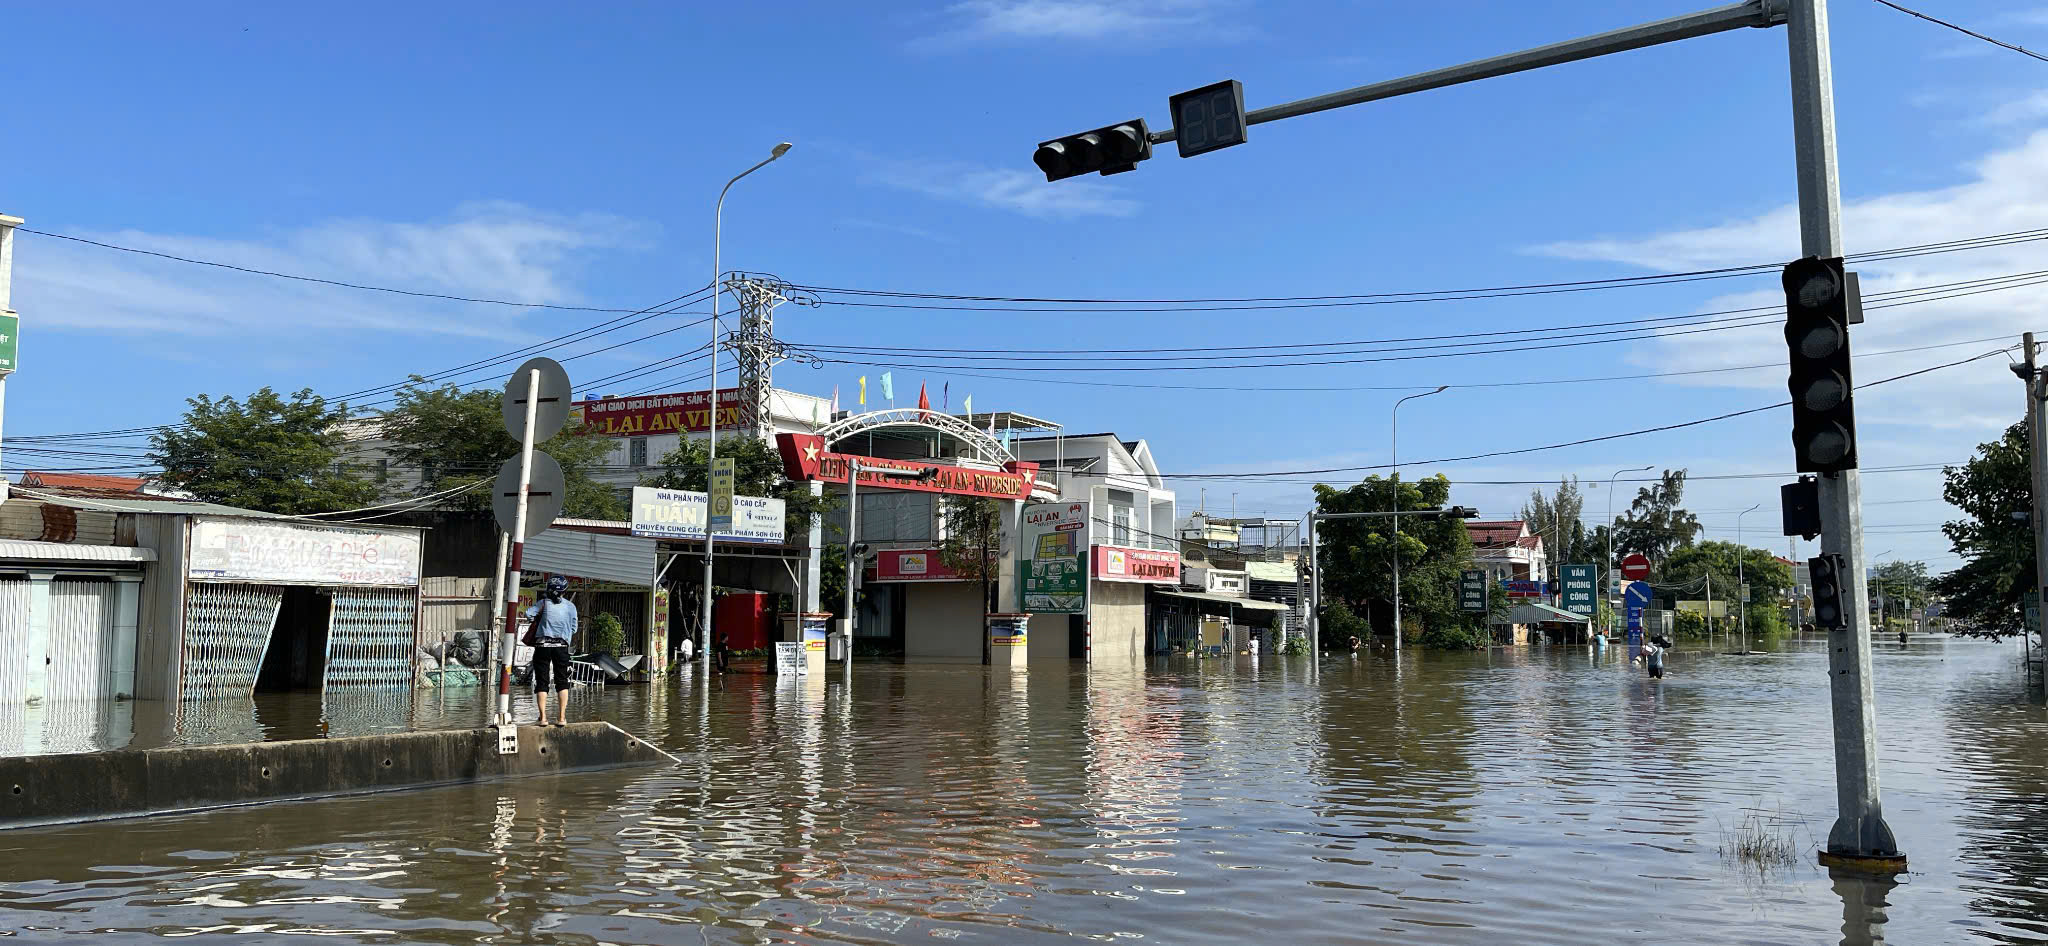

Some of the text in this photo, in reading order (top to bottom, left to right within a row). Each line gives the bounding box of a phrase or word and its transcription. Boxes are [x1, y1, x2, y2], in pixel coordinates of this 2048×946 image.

[608, 401, 625, 411] GIAO
[650, 412, 682, 431] AN
[819, 456, 846, 480] KHU
[740, 499, 753, 507] CAO
[1045, 511, 1059, 521] AN
[1571, 567, 1586, 577] VĂN
[1567, 580, 1590, 589] PHÒNG
[518, 595, 533, 607] Pha
[1569, 591, 1589, 601] CÔNG
[1568, 604, 1592, 613] CHỨNG
